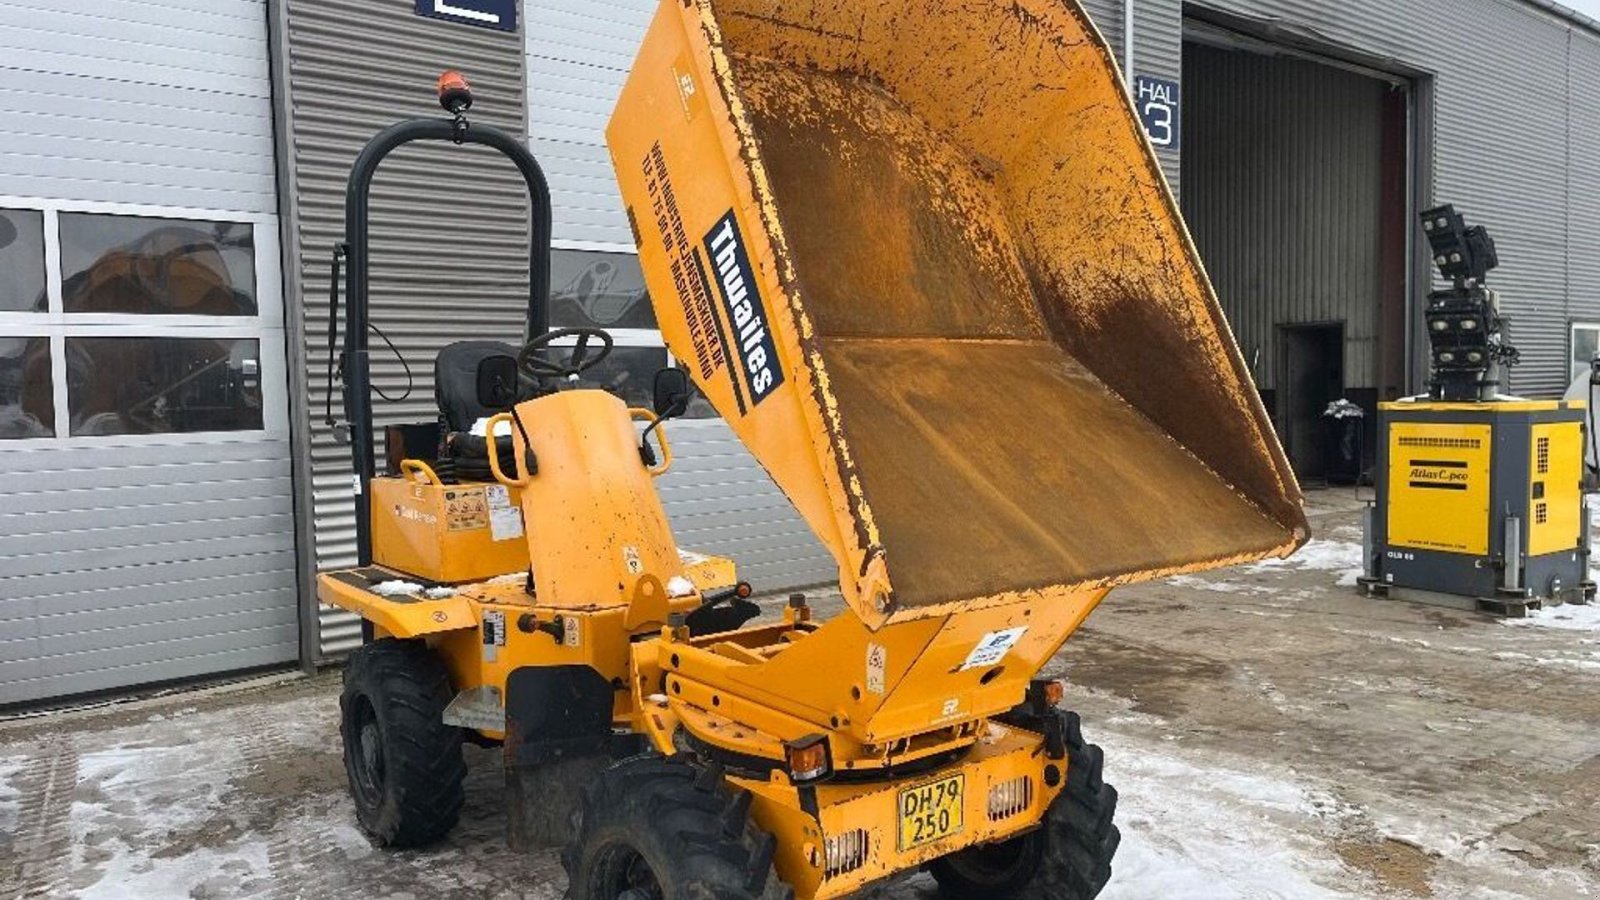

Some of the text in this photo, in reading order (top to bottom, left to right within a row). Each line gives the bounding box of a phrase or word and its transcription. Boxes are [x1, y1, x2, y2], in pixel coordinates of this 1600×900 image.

[1139, 79, 1177, 106] HAL
[1145, 102, 1172, 146] 3
[711, 218, 773, 395] Thwaites
[1409, 468, 1438, 479] Atlas
[913, 808, 950, 842] 250
